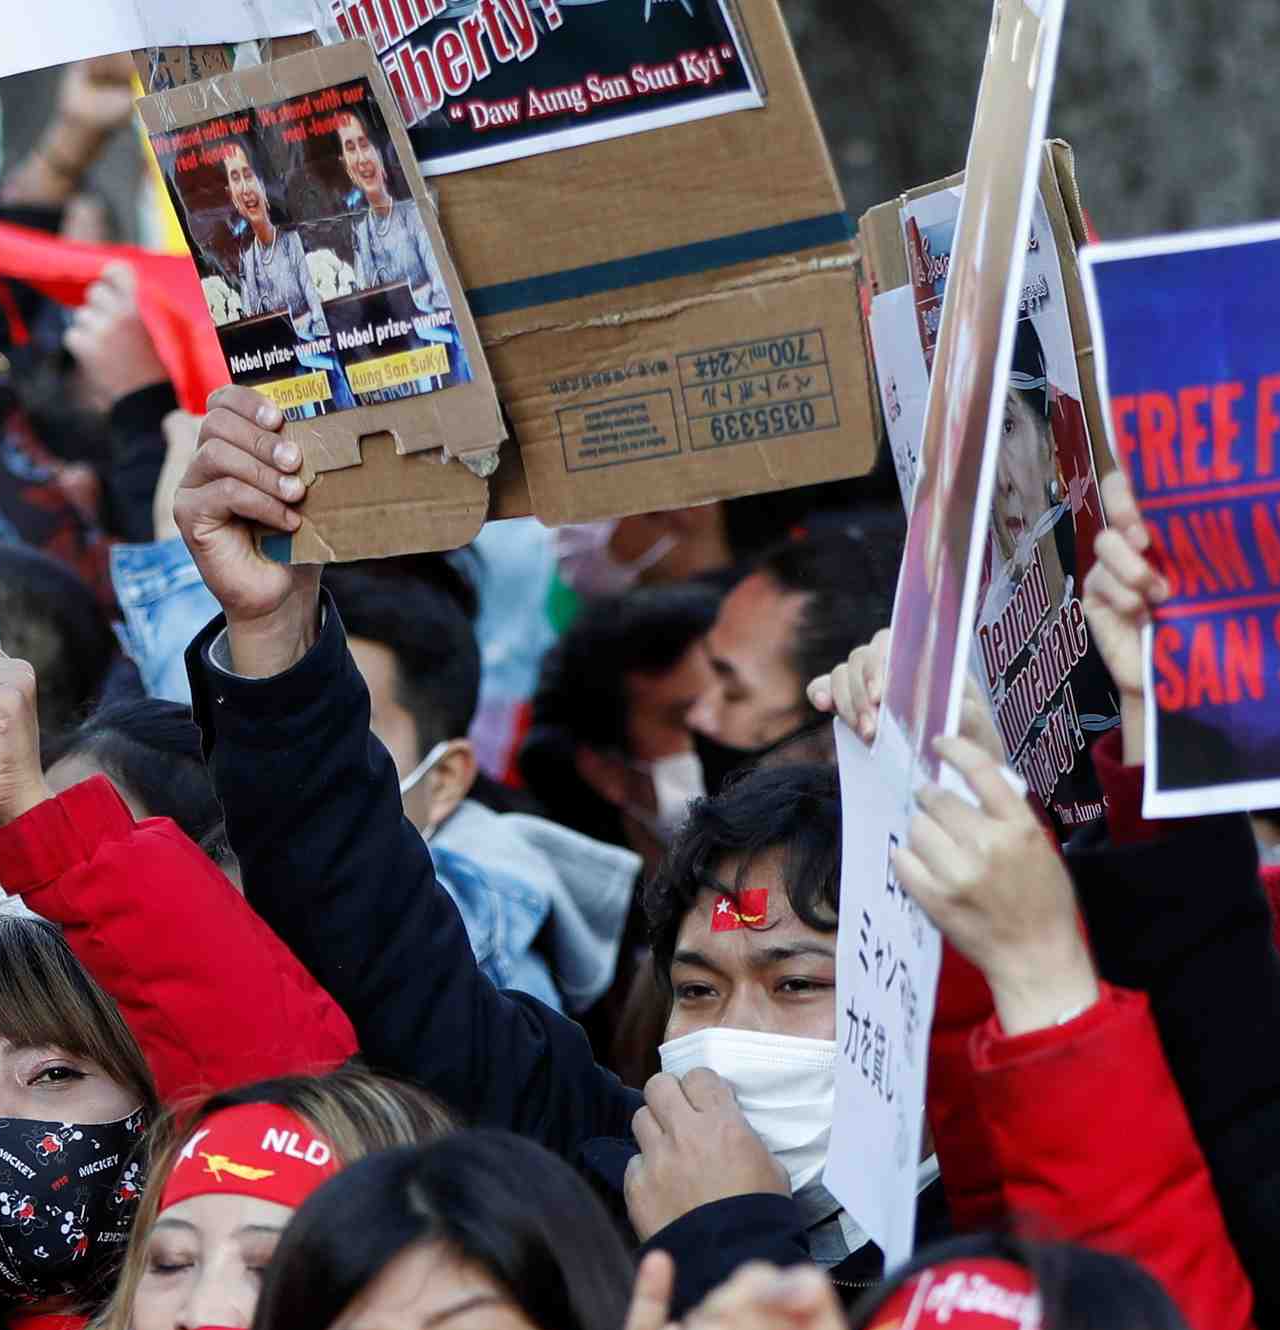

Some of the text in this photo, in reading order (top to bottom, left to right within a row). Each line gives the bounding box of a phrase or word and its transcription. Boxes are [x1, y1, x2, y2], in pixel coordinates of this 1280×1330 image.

[470, 99, 519, 128] Daw
[528, 86, 587, 117] Aung
[589, 77, 629, 102] San
[632, 66, 677, 92] Suu
[682, 54, 721, 85] Kyi
[336, 329, 375, 350] Nobel
[230, 351, 264, 374] Nobel
[709, 401, 816, 443] 0355339
[1111, 381, 1244, 491] FREE
[1144, 508, 1254, 597] DAW
[1154, 615, 1265, 712] SAN
[78, 1153, 120, 1178] MICKEY
[261, 1127, 331, 1167] NLD
